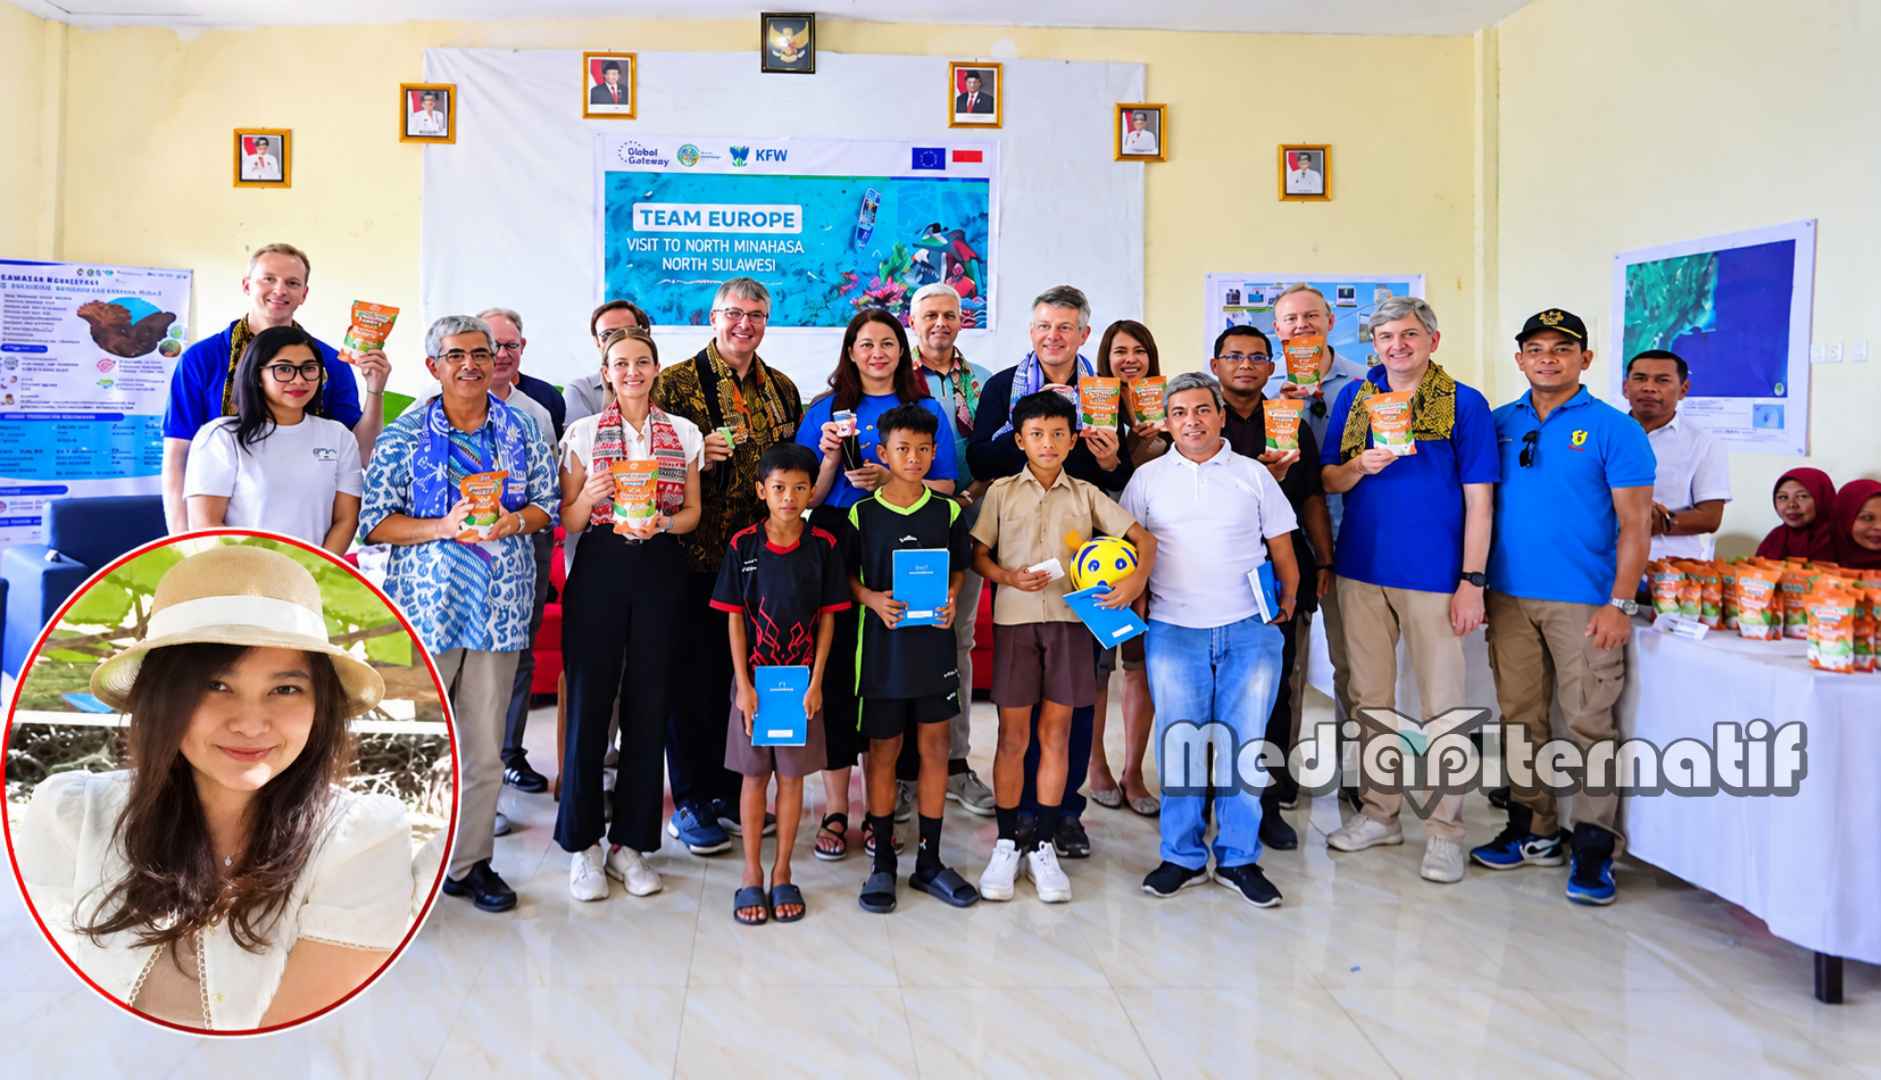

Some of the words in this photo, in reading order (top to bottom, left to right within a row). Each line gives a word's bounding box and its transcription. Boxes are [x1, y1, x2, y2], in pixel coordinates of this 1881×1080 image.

[628, 147, 658, 157] Global
[755, 149, 788, 162] KFW
[627, 156, 669, 168] Gateway
[640, 209, 701, 227] TEAM
[708, 211, 796, 229] EUROPE
[626, 237, 659, 252] VISIT
[664, 238, 681, 252] TO
[685, 239, 730, 253] NORTH
[734, 240, 805, 254] MINAHASA
[662, 257, 708, 271] NORTH
[712, 258, 776, 273] SULAWESI
